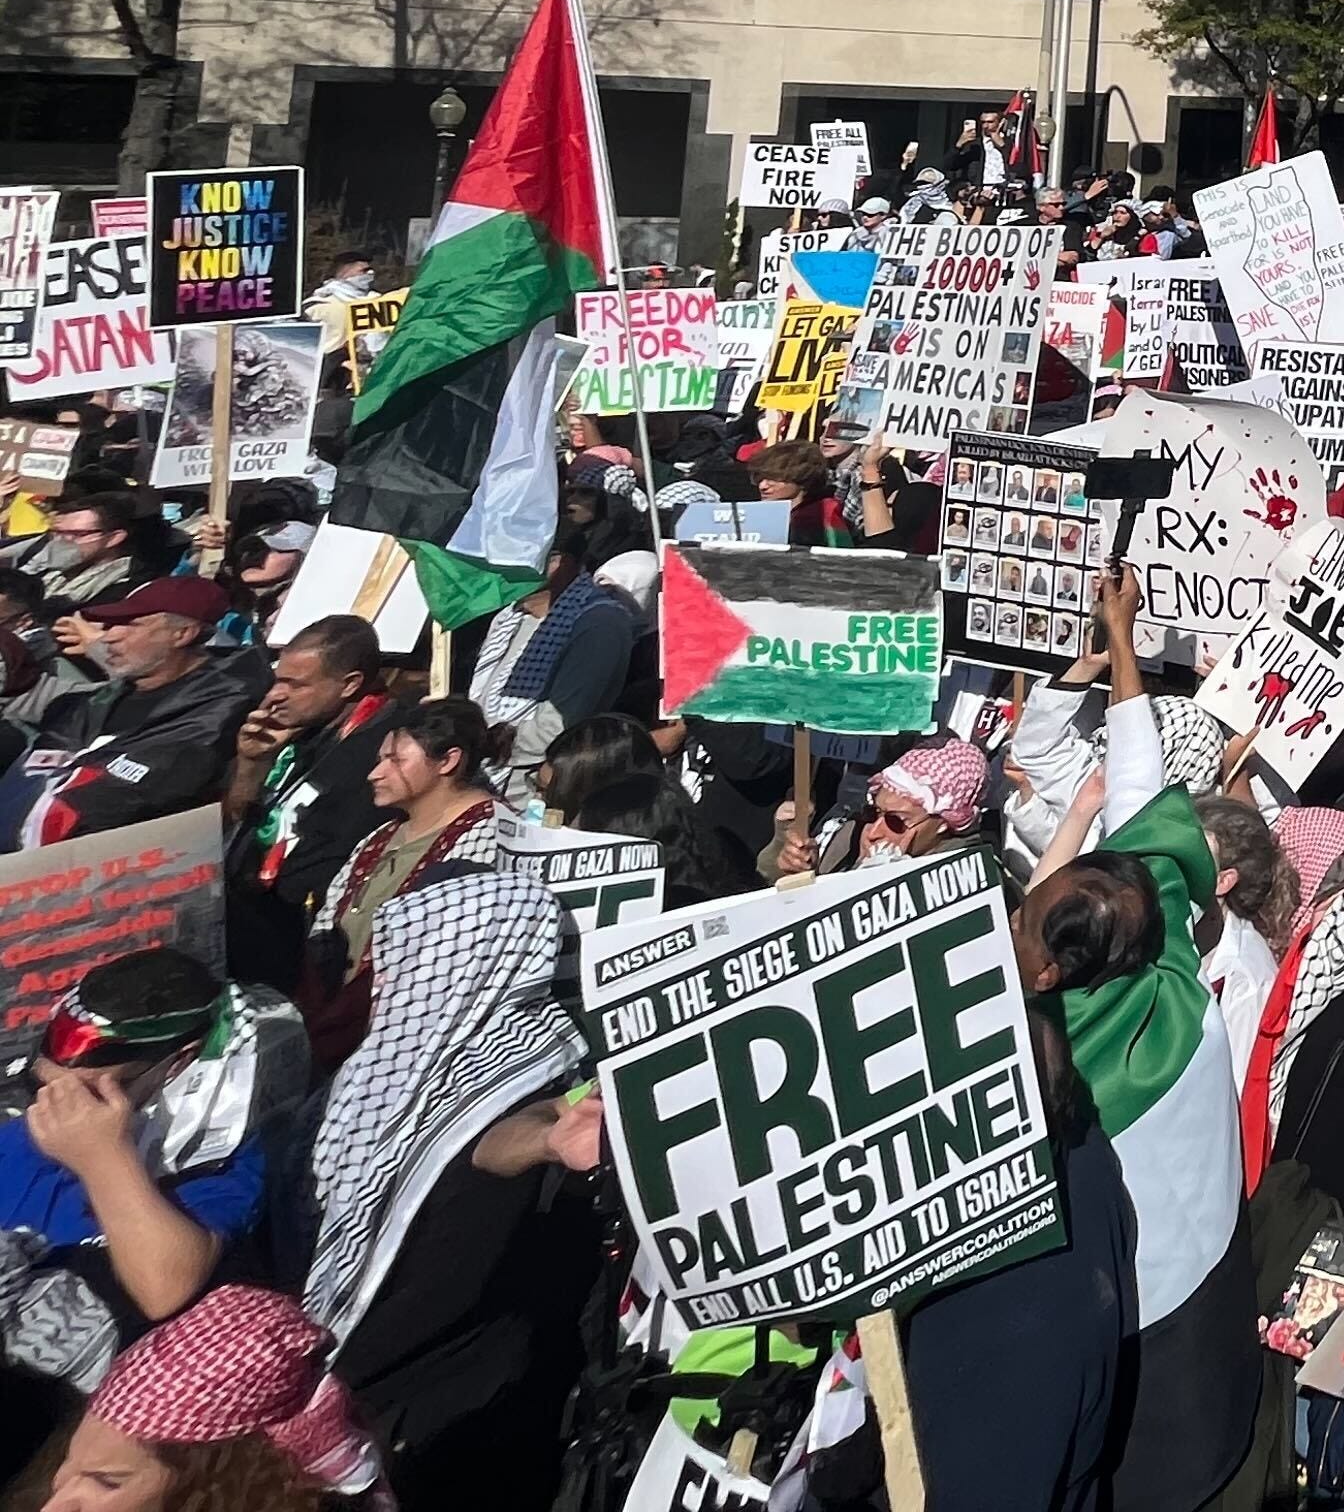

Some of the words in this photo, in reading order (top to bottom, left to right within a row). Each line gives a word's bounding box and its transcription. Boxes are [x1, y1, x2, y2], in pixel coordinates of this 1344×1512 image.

[754, 146, 830, 164] CEASE
[762, 169, 816, 187] FIRE
[180, 180, 275, 214] KNOW
[769, 189, 822, 206] NOW
[162, 211, 288, 250] JUSTICE
[779, 233, 828, 252] STOP
[886, 227, 928, 255] THE
[935, 227, 1021, 257] BLOOD
[1028, 228, 1054, 258] OF
[1272, 224, 1309, 244] KILL
[1289, 237, 1313, 254] NOT
[178, 244, 274, 281] KNOW
[923, 257, 1015, 293] 10000+
[176, 277, 274, 314] PEACE
[865, 289, 1041, 327] PALESTINIANS
[1169, 278, 1212, 302] FREE
[580, 292, 719, 331] FREEDOM
[1237, 304, 1279, 337] SAVE
[619, 328, 691, 364] FOR
[917, 328, 943, 357] IS
[955, 329, 990, 360] ON
[871, 360, 1006, 403] AMERICA'S
[234, 458, 276, 473] LOVE
[238, 441, 287, 458] GAZA
[1160, 438, 1224, 491] MY
[1157, 506, 1229, 556] RX:
[847, 615, 939, 646] FREE
[746, 635, 939, 674] PALESTINE
[548, 853, 572, 881] ON
[575, 848, 613, 878] GAZA
[618, 845, 658, 872] NOW!
[599, 930, 693, 981] ANSWER
[603, 1007, 658, 1052] END
[662, 981, 718, 1026] THE
[722, 942, 799, 1003] SIEGE
[805, 919, 844, 962] ON
[853, 886, 918, 942] GAZA
[922, 851, 990, 915] NOW!
[612, 903, 1018, 1224] FREE
[652, 1063, 1034, 1292] PALESTINE!
[690, 1284, 743, 1327] END
[746, 1270, 792, 1315] ALL
[799, 1245, 855, 1301] U.S.
[864, 1222, 908, 1272] AID
[912, 1201, 948, 1246] TO
[956, 1150, 1047, 1223] ISRAEL
[870, 1198, 1054, 1307] @ANSWERCOALITION
